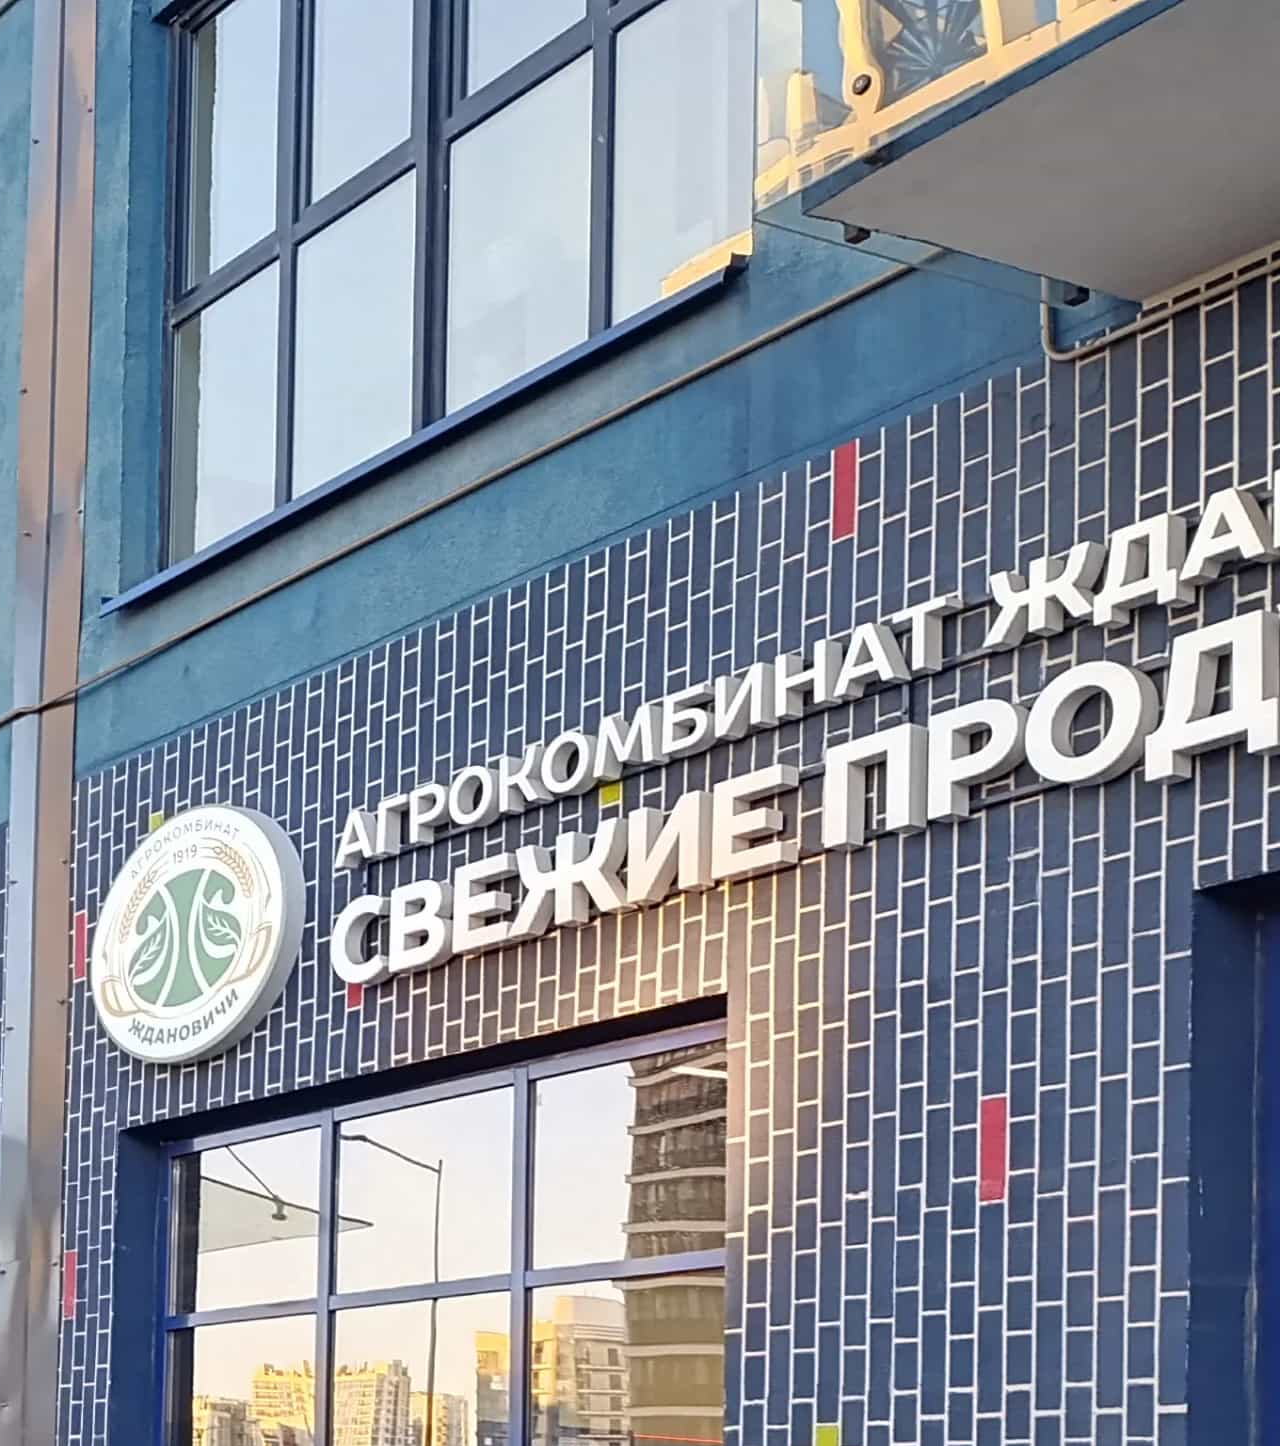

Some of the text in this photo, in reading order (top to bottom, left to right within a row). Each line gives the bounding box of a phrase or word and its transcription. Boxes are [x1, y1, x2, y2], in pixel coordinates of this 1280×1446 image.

[334, 488, 1280, 870] АГРОКОМБИНАТ ЖДА
[330, 608, 1280, 986] СВЕЖИЕ ПРОД
[131, 819, 240, 880] АГРОКОМБИНАТ
[172, 844, 198, 864] 1919
[128, 987, 240, 1046] ЖДАНОВИЧИ
